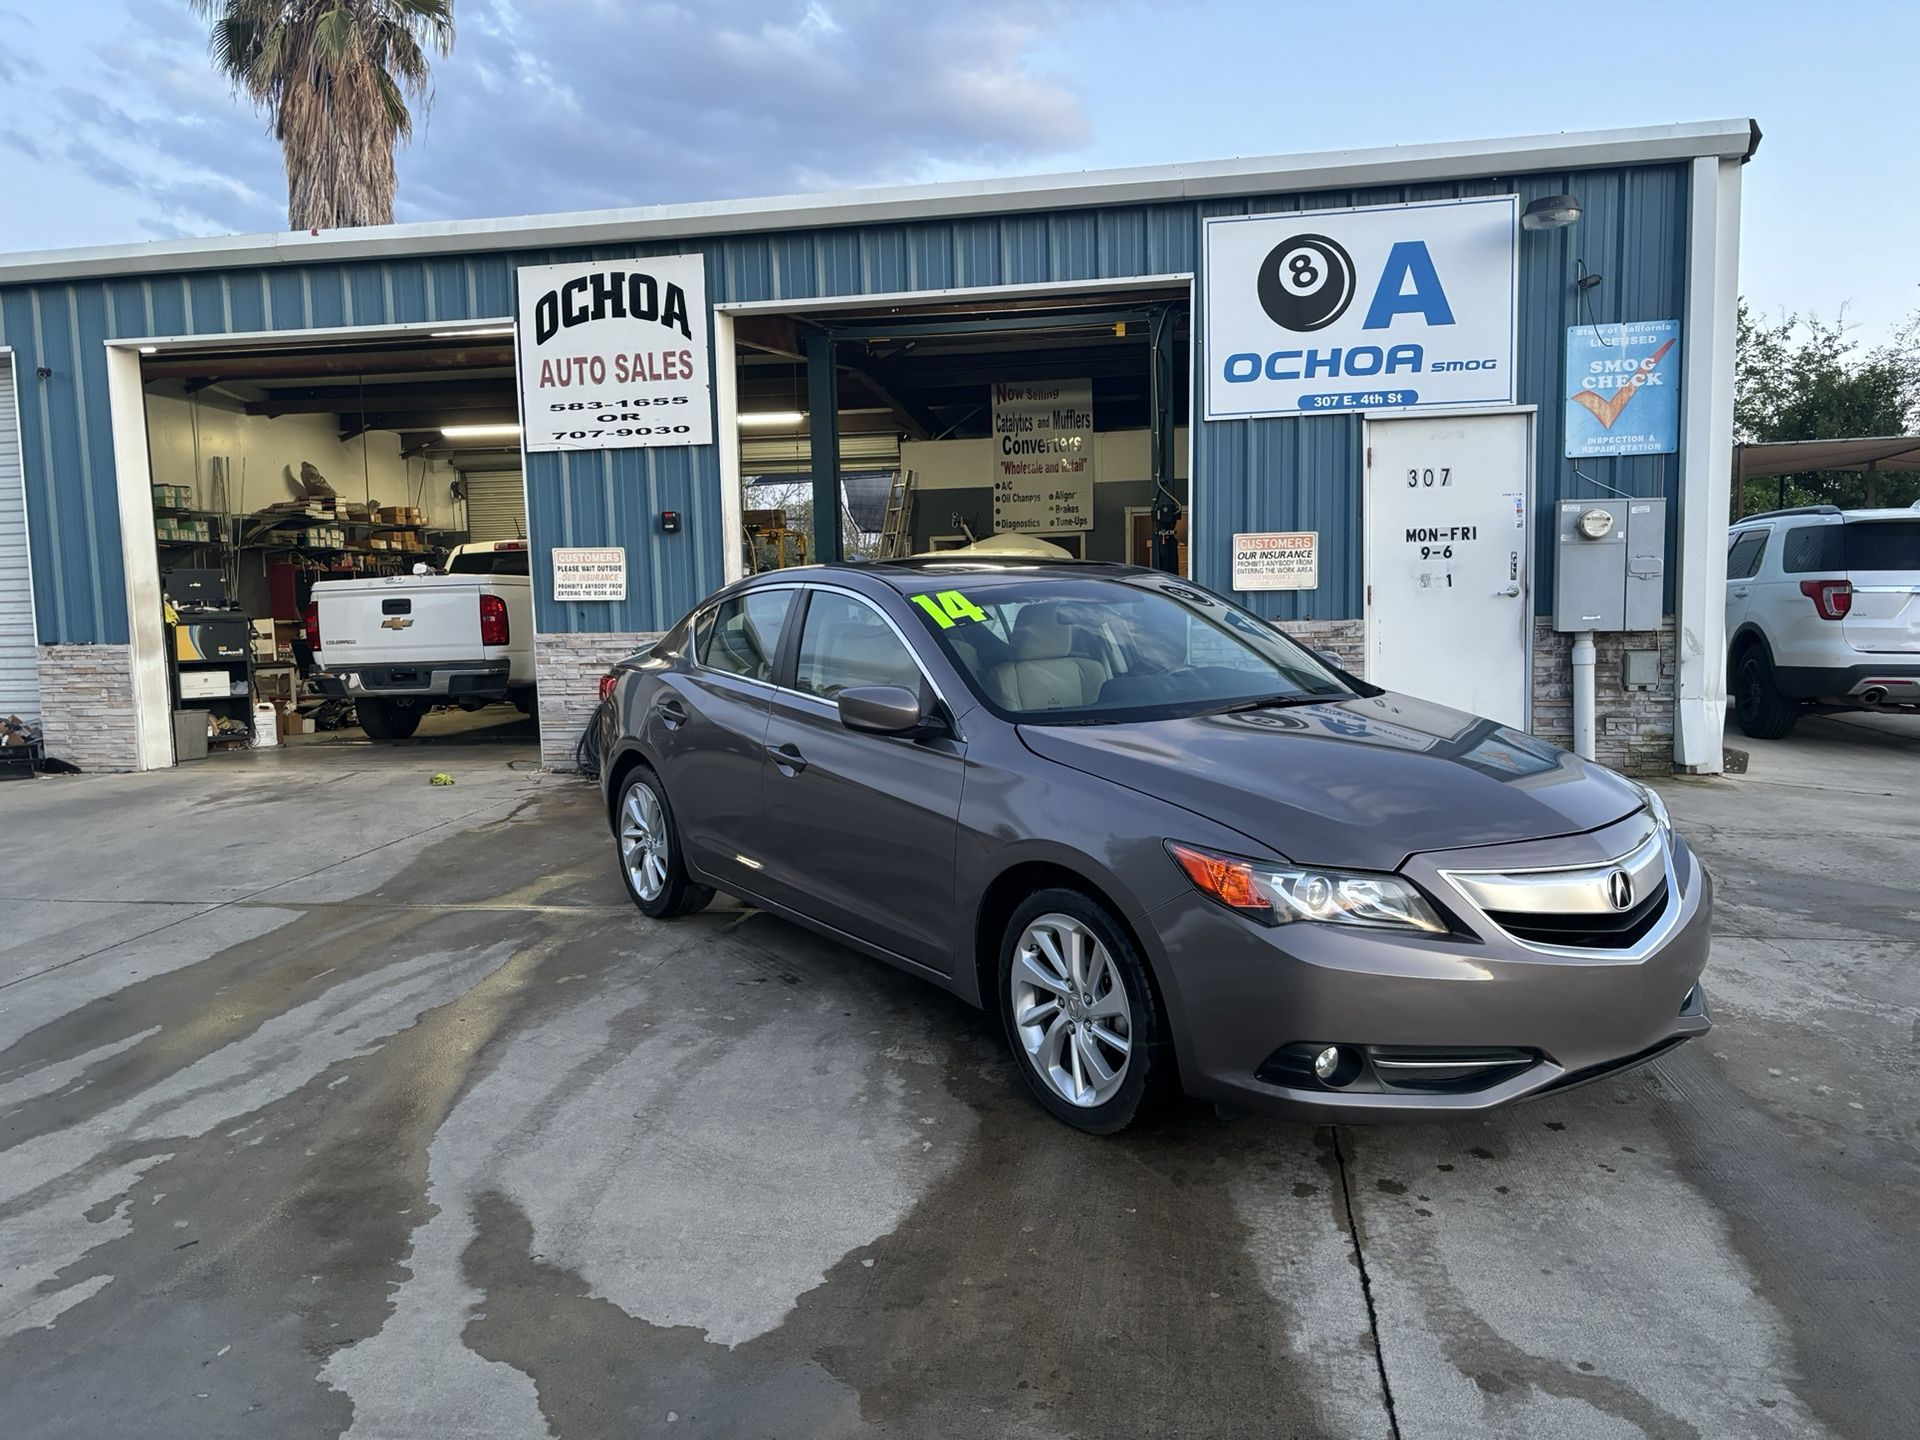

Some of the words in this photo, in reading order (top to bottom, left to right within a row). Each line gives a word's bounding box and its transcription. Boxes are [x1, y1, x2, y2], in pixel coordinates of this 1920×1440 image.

[1362, 240, 1456, 330] A
[535, 271, 692, 346] OCHOA
[1624, 324, 1671, 333] alifornia
[539, 355, 606, 389] AUTO
[614, 350, 694, 384] SALES
[1223, 344, 1424, 384] OCHOA
[1430, 359, 1498, 373] SMOG
[1589, 358, 1657, 373] SMOG
[1582, 373, 1664, 389] CHECK
[996, 383, 1023, 405] Now
[1026, 388, 1060, 401] Selling
[1314, 397, 1339, 407] 307
[1344, 395, 1356, 406] E.
[1360, 394, 1383, 405] 4th
[1388, 393, 1403, 404] St
[550, 396, 688, 412] 583-1655
[596, 413, 641, 422] OR
[996, 412, 1033, 437] Catalytics
[1037, 416, 1050, 429] and
[1053, 409, 1091, 430] Mufflers
[552, 425, 691, 440] 707-9030
[1587, 434, 1644, 445] INSPECTION
[1583, 445, 1616, 453] REPAIR
[1620, 443, 1662, 452] STATION
[1045, 461, 1059, 474] and
[1408, 468, 1450, 488] 307
[1001, 493, 1011, 503] Oil
[1055, 504, 1080, 514] Brakes
[1001, 519, 1040, 531] Diagnostics
[1056, 516, 1088, 527] Tune-Ups
[1406, 526, 1477, 543] MON-FRI
[1240, 538, 1311, 549] CUSTOMERS
[558, 553, 620, 563] CUSTOMERS
[1237, 551, 1257, 560] OUR
[1259, 550, 1313, 560] INSURANCE
[1421, 545, 1453, 560] 9-6
[1266, 559, 1294, 567] ANYBODY
[562, 574, 577, 582] OUR
[579, 573, 618, 581] INSURANCE
[1237, 567, 1264, 575] ENTERING
[910, 590, 987, 630] 14
